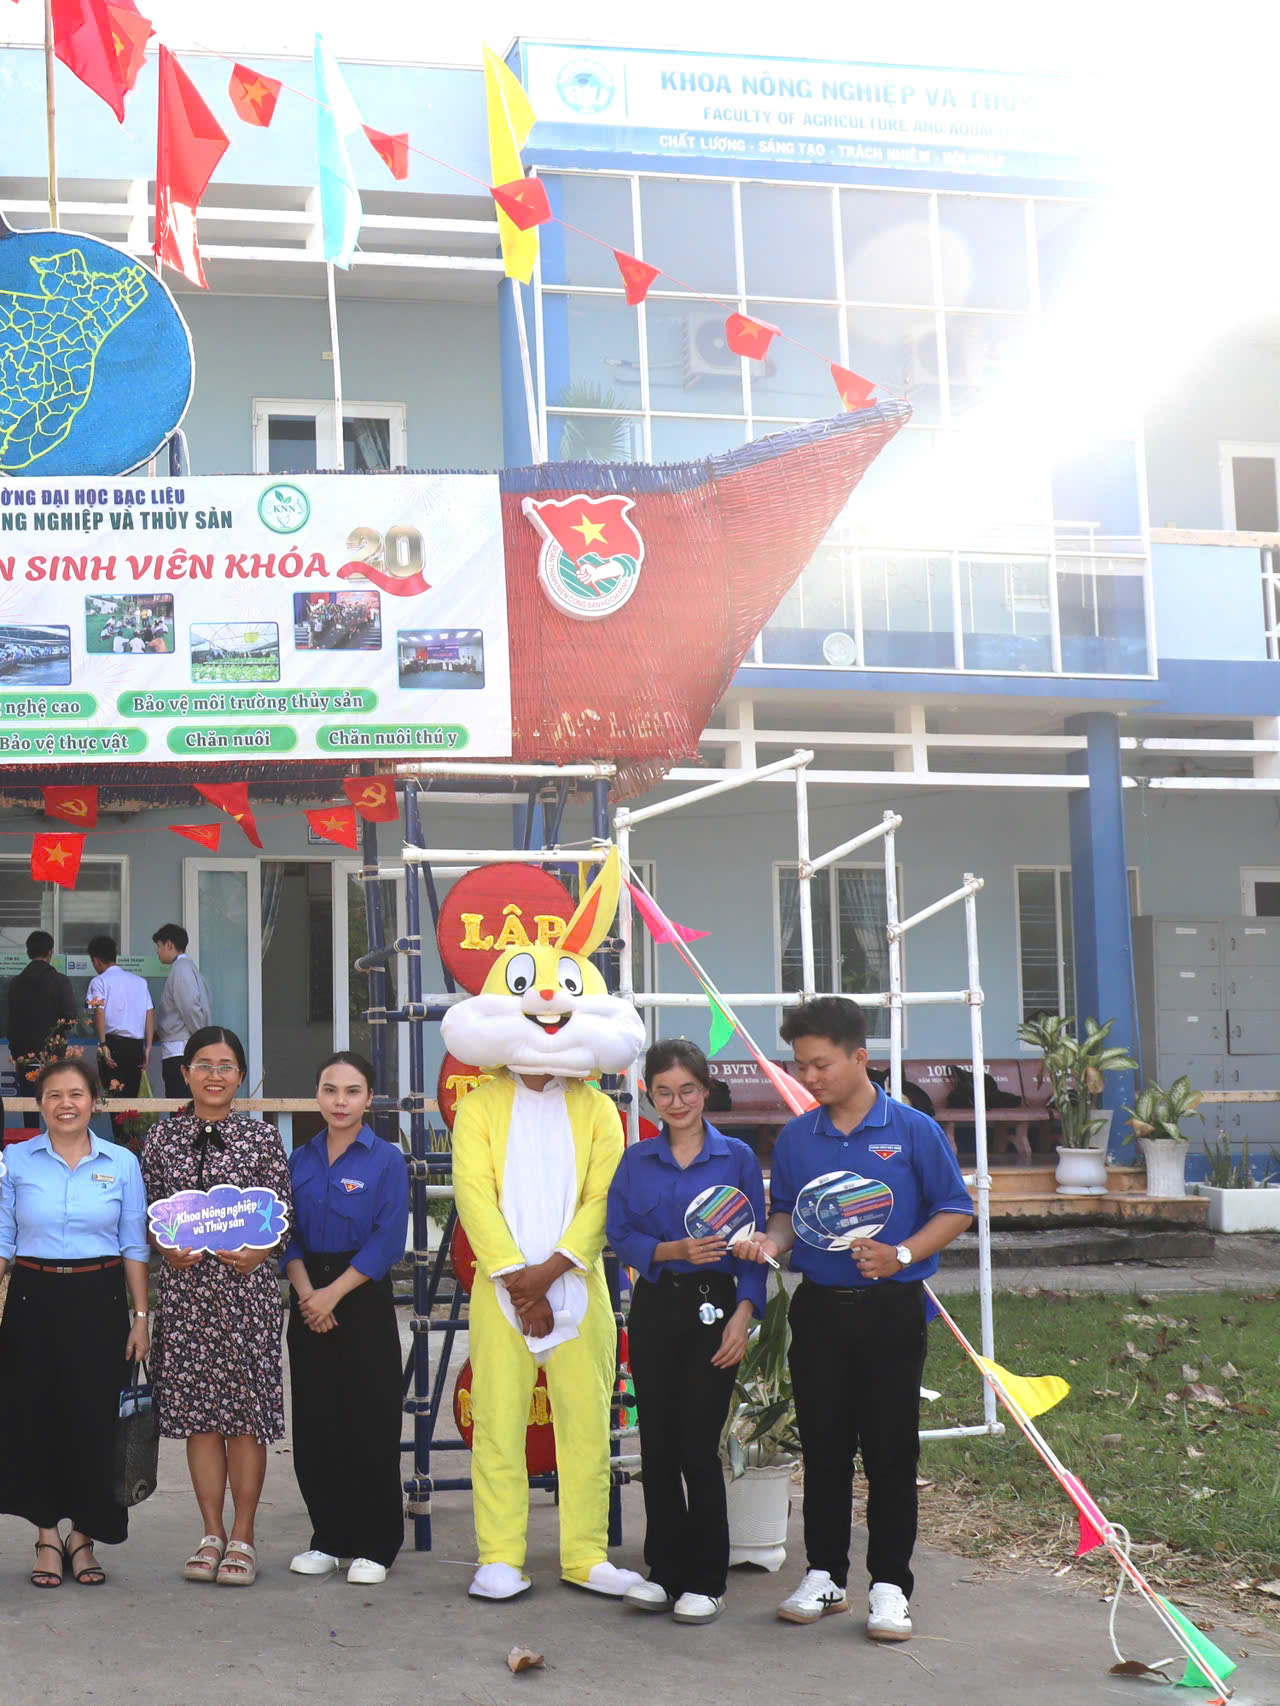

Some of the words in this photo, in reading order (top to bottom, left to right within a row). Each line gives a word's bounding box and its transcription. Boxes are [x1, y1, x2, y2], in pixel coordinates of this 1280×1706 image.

[660, 72, 732, 94] KHOA
[741, 71, 813, 99] NÔNG
[820, 77, 917, 109] NGHIỆP
[704, 106, 772, 123] FACULTY
[777, 111, 796, 125] OF
[803, 111, 906, 132] AGRICULTURE
[659, 132, 696, 150] CHẤT
[700, 135, 746, 154] LƯỢNG
[759, 137, 797, 153] SÁNG
[800, 142, 825, 158] TẠO
[837, 143, 883, 161] TRÁCH
[41, 489, 70, 508] ĐẠI
[74, 488, 109, 508] HỌC
[113, 488, 146, 508] BẠC
[151, 486, 185, 505] LIÊU
[273, 504, 296, 513] KNN
[33, 509, 104, 534] NGHIỆP
[109, 508, 135, 531] VÀ
[139, 507, 189, 530] THỦY
[195, 506, 233, 530] SẢN
[24, 555, 118, 582] SINH
[125, 547, 215, 581] VIÊN
[224, 545, 331, 580] KHÓA
[344, 525, 427, 583] 20
[6, 698, 47, 718] nghệ
[51, 702, 81, 714] cao
[133, 694, 165, 712] Bảo
[169, 696, 188, 715] vệ
[193, 695, 226, 711] môi
[229, 693, 287, 712] trường
[292, 692, 329, 711] thủy
[333, 691, 363, 708] sản
[0, 734, 31, 751] Bảo
[35, 735, 55, 754] vệ
[59, 734, 97, 754] thực
[101, 734, 129, 753] vật
[185, 732, 228, 749] Chăn
[232, 731, 271, 748] nuôi
[329, 730, 370, 745] Chăn
[375, 729, 411, 744] nuôi
[416, 729, 443, 744] thú
[447, 732, 458, 746] y
[722, 1064, 758, 1075] BVTV
[177, 1211, 202, 1225] Khoa
[201, 1206, 226, 1222] Nông
[226, 1197, 258, 1218] nghiệp
[192, 1223, 206, 1236] và
[206, 1217, 230, 1233] Thủy
[229, 1216, 246, 1229] sản
